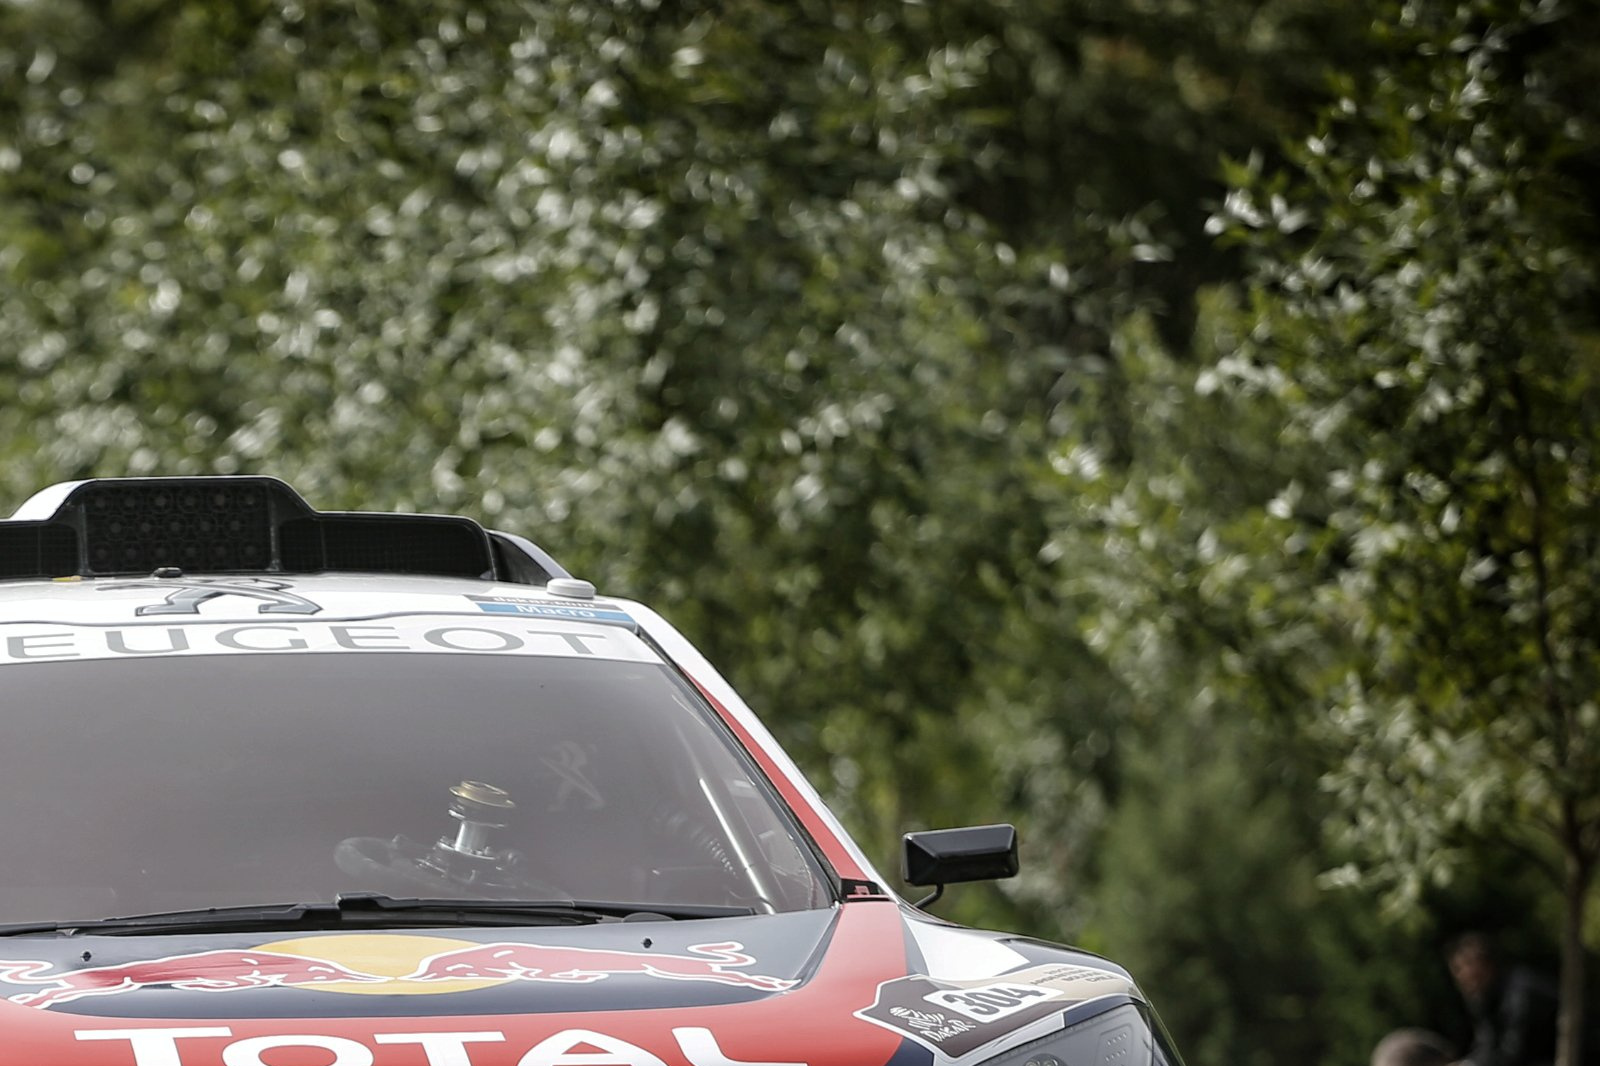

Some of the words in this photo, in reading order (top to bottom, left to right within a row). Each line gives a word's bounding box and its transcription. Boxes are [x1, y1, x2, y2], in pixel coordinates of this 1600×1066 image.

[515, 605, 596, 618] Macro
[941, 988, 1047, 1015] 304
[919, 1019, 977, 1042] DAKAR
